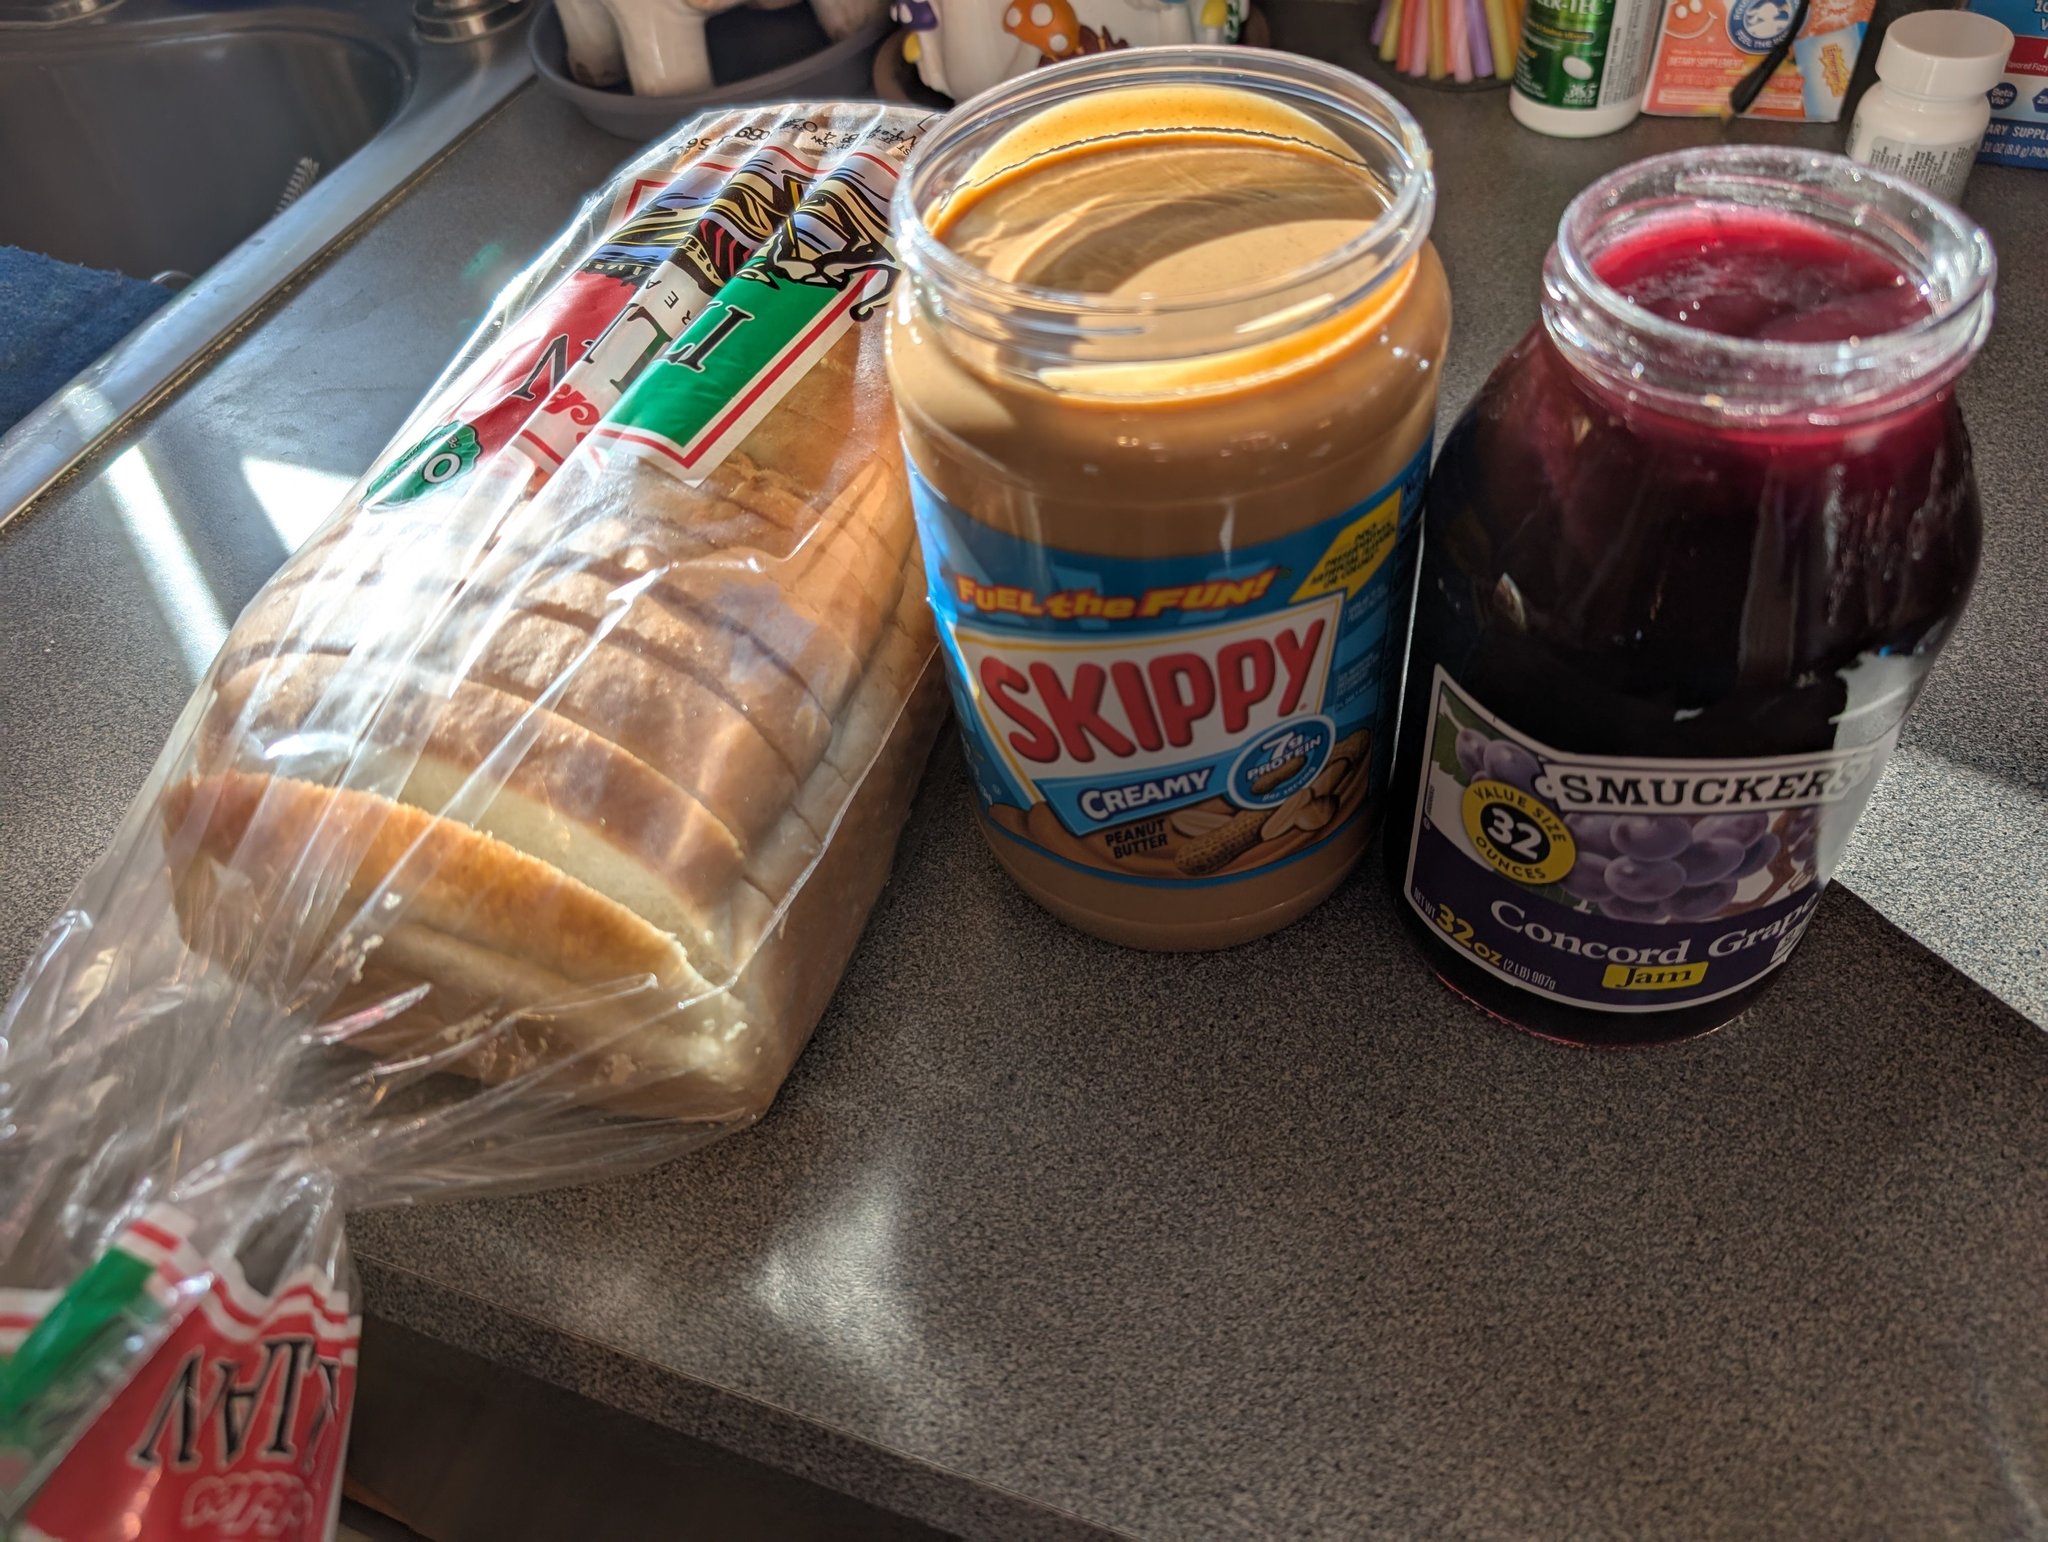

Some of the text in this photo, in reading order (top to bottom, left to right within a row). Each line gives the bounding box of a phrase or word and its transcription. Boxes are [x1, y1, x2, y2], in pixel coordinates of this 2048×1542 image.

[1986, 123, 2008, 136] ARY
[957, 567, 1279, 619] FUEL the FUN!
[979, 617, 1326, 764] SKIPPY
[1247, 735, 1321, 780] PROTEIN
[1081, 764, 1215, 821] CREAMY
[1473, 785, 1566, 842] VALUE SIZE
[1105, 818, 1166, 848] PEANUT
[1113, 833, 1168, 860] BUTTER
[1487, 807, 1542, 860] 32
[1476, 836, 1546, 879] OUNCES
[1425, 898, 1437, 920] WT
[1490, 899, 1688, 966] Concord
[1616, 966, 1692, 988] Jam
